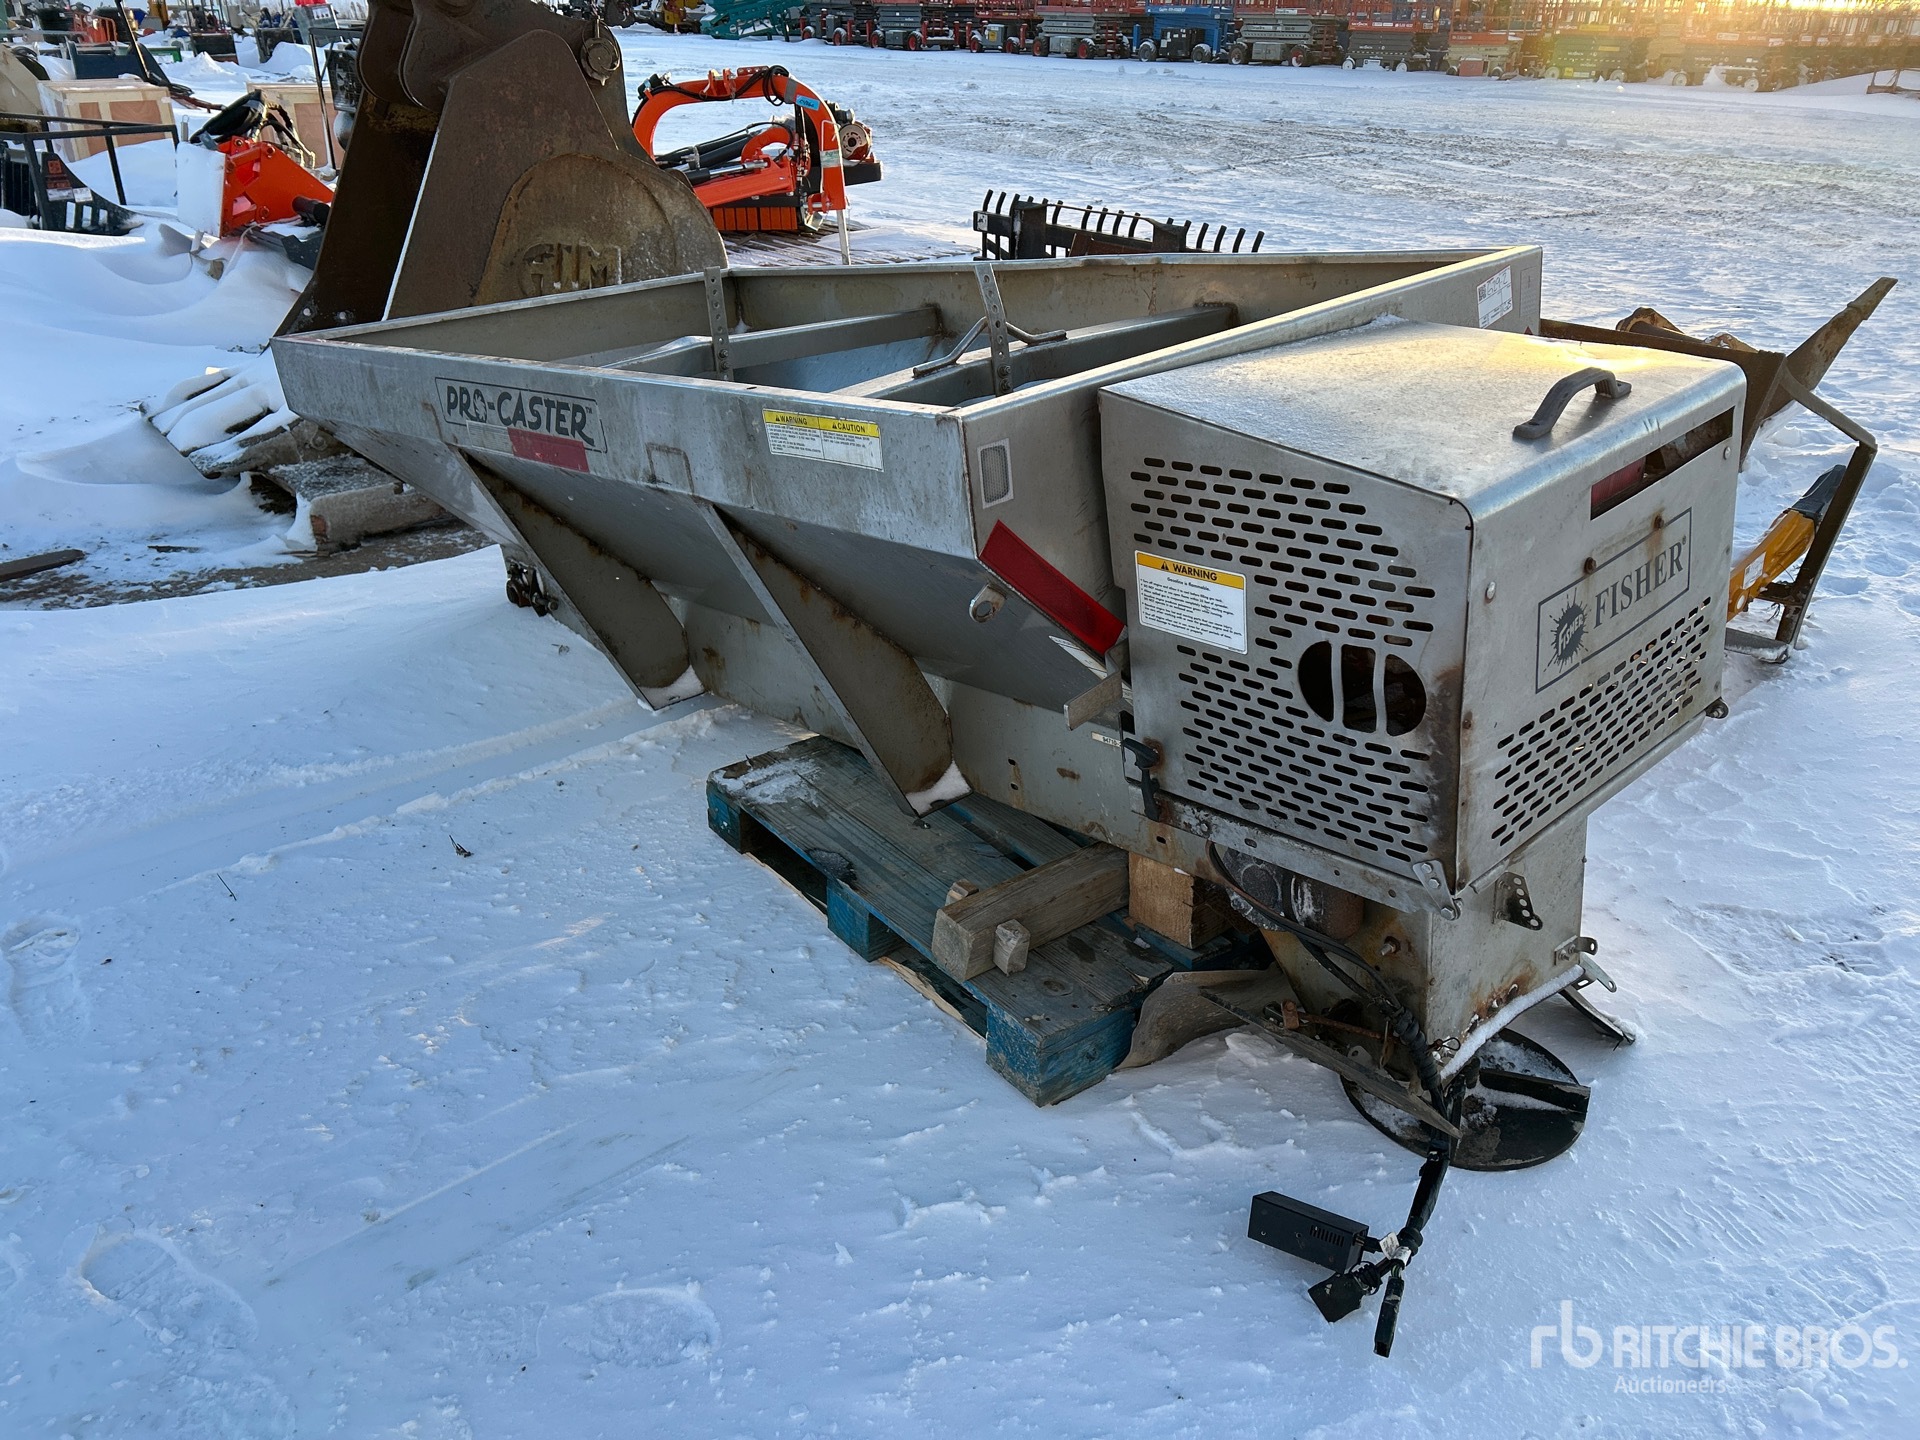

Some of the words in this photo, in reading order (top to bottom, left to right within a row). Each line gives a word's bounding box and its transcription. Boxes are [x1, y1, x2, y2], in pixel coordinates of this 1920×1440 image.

[446, 385, 597, 448] PRO-CASTER
[837, 421, 866, 434] CAUTION
[1172, 563, 1218, 581] WARNING
[1593, 541, 1684, 629] FISHER
[1558, 613, 1585, 657] FISHER
